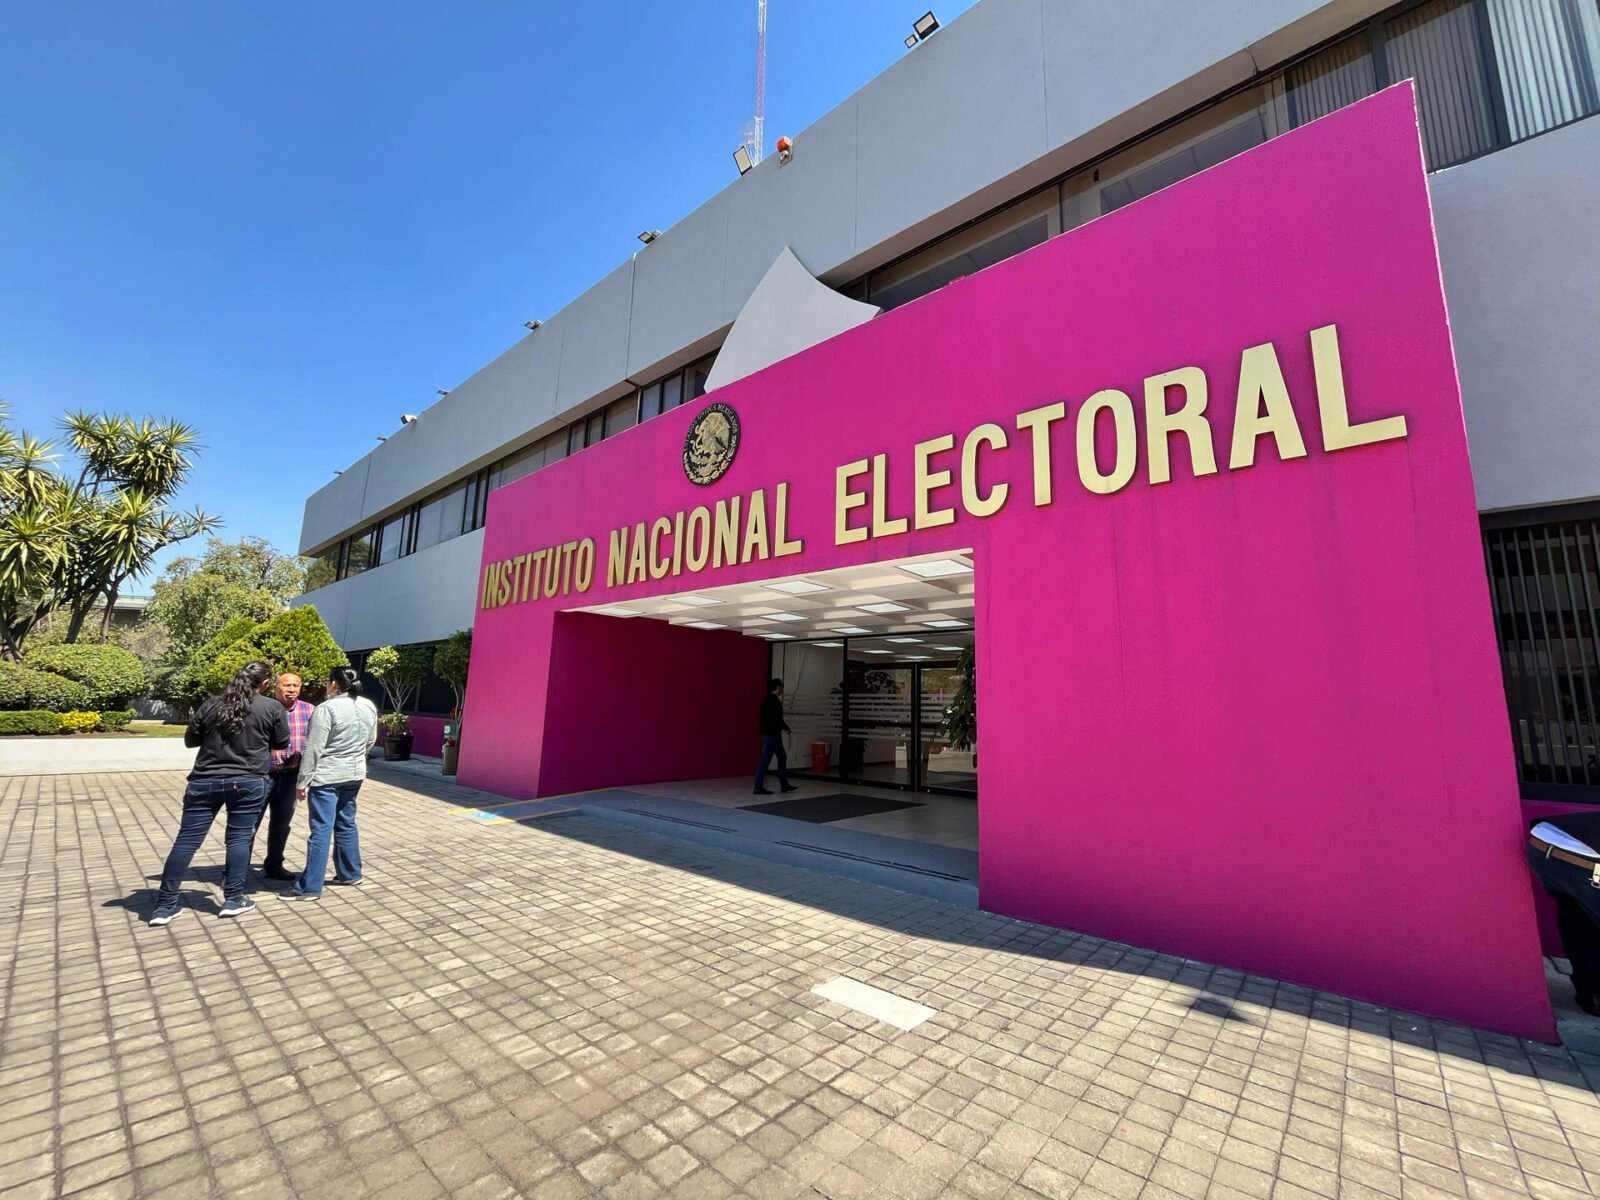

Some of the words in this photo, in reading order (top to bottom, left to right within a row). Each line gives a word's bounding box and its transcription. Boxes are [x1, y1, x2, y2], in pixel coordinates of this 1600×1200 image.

[482, 538, 595, 609] INSTITUTO
[607, 482, 803, 588] NACIONAL
[834, 324, 1408, 546] ELECTORAL
